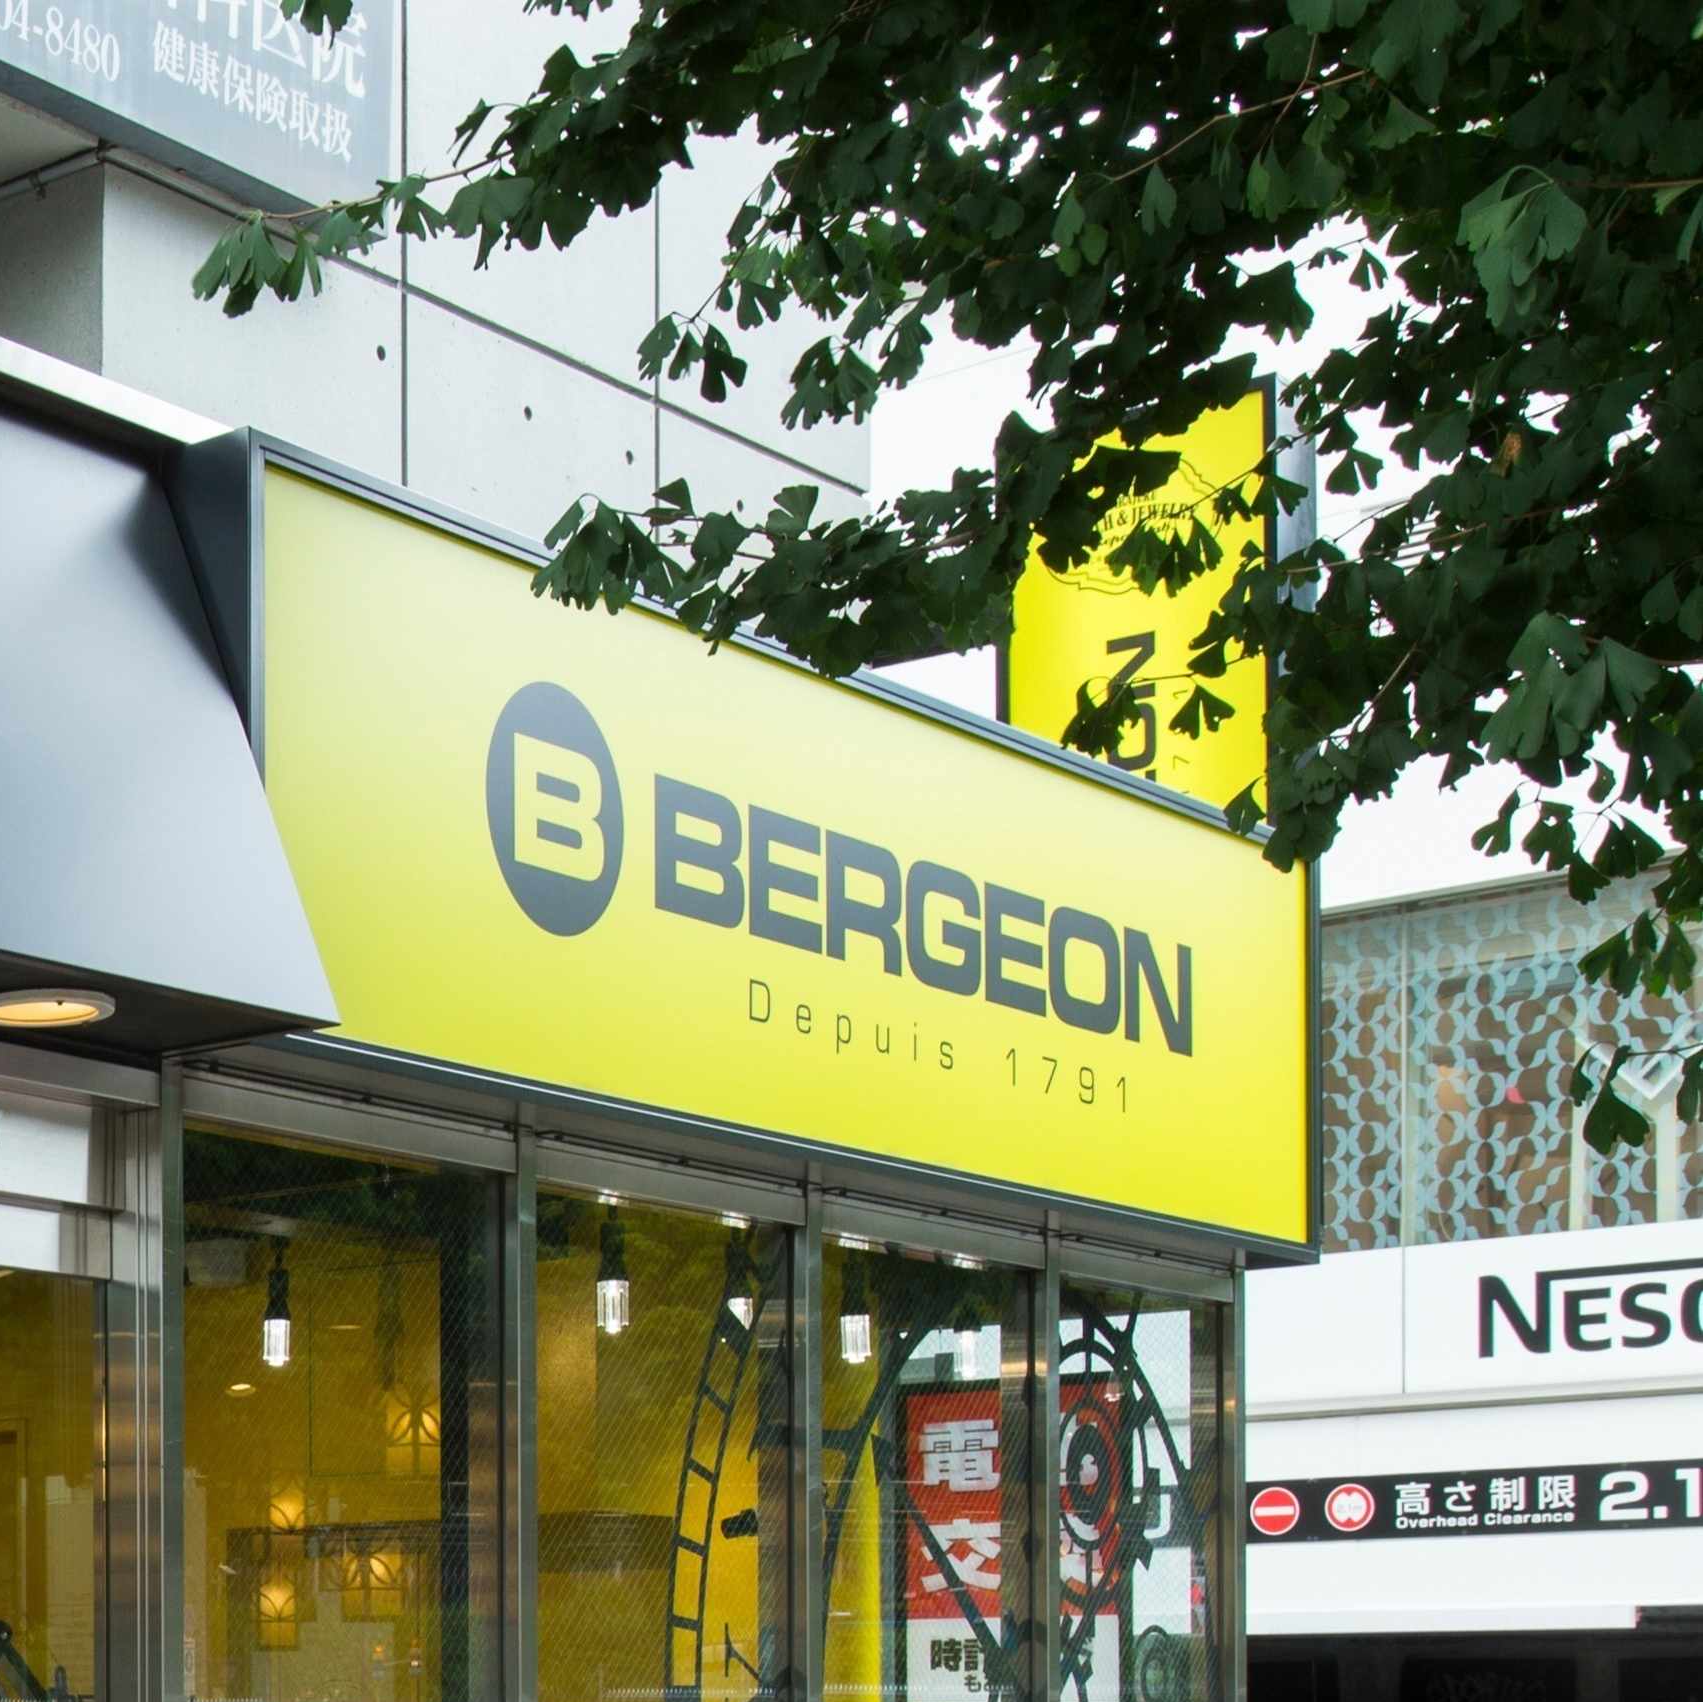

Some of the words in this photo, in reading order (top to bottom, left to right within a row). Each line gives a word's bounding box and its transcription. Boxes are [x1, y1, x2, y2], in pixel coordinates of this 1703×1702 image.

[153, 20, 352, 162] 健康保険取扱
[654, 773, 1193, 1057] BERGEON
[749, 979, 954, 1071] Depuis
[1005, 1047, 1128, 1113] 1791
[1395, 1475, 1576, 1516] 高さ制限
[1396, 1514, 1478, 1530] Overhead
[1484, 1512, 1575, 1526] Clearance
